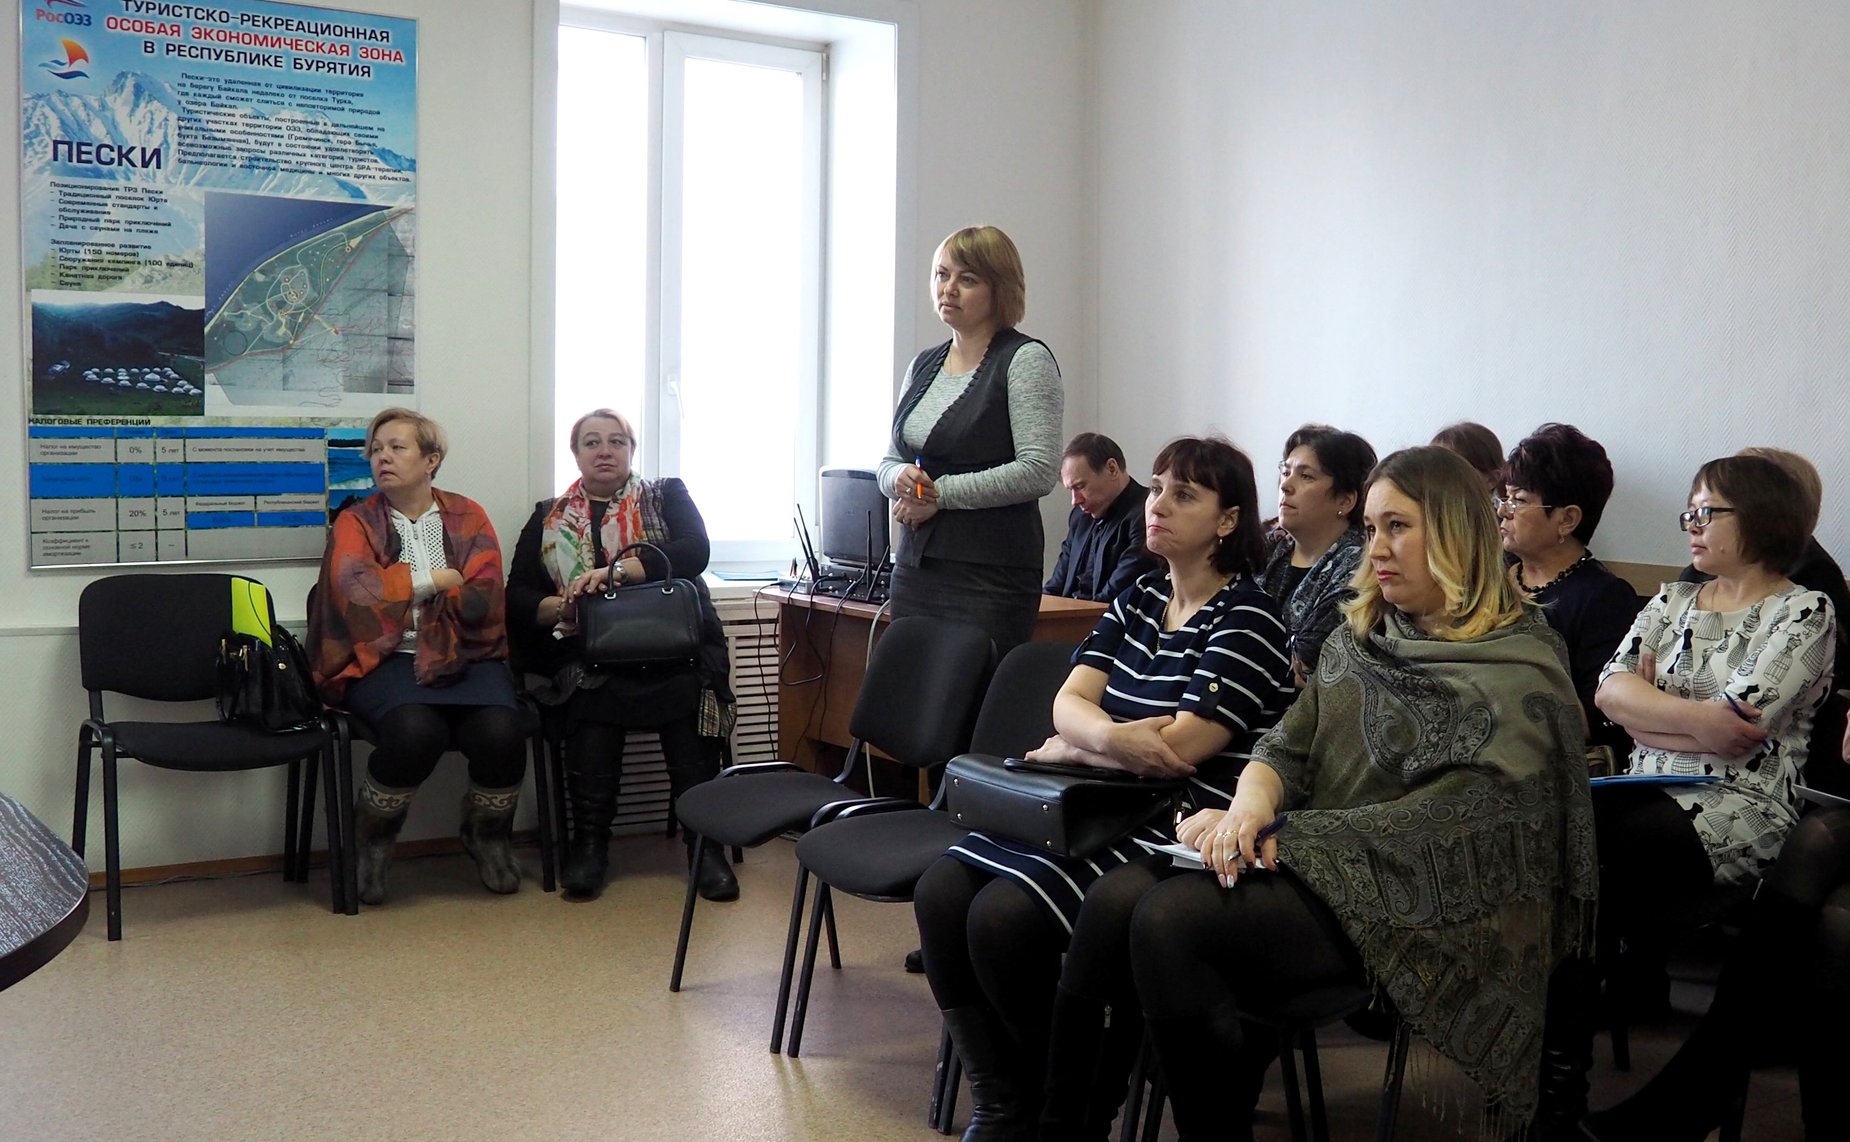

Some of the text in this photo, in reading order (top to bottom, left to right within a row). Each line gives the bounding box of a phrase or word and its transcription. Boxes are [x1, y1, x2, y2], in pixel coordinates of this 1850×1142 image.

[36, 8, 92, 26] РосОЭЗ
[123, 0, 390, 42] ТУРИСТСКО-РЕКРЕАЦИОННАЯ
[106, 16, 404, 63] ОСОБАЯ ЭКОНОМИЧЕСКАЯ ЗОНА
[144, 41, 371, 78] В РЕСПУБЛИКЕ БУРЯТИЯ
[53, 140, 162, 170] ПЕСКИ
[86, 418, 151, 426] ПРЕФЕРЕНЦИИ
[129, 446, 143, 454] 0%
[161, 446, 167, 454] 5
[129, 510, 147, 518] 20%
[162, 509, 168, 517] 5
